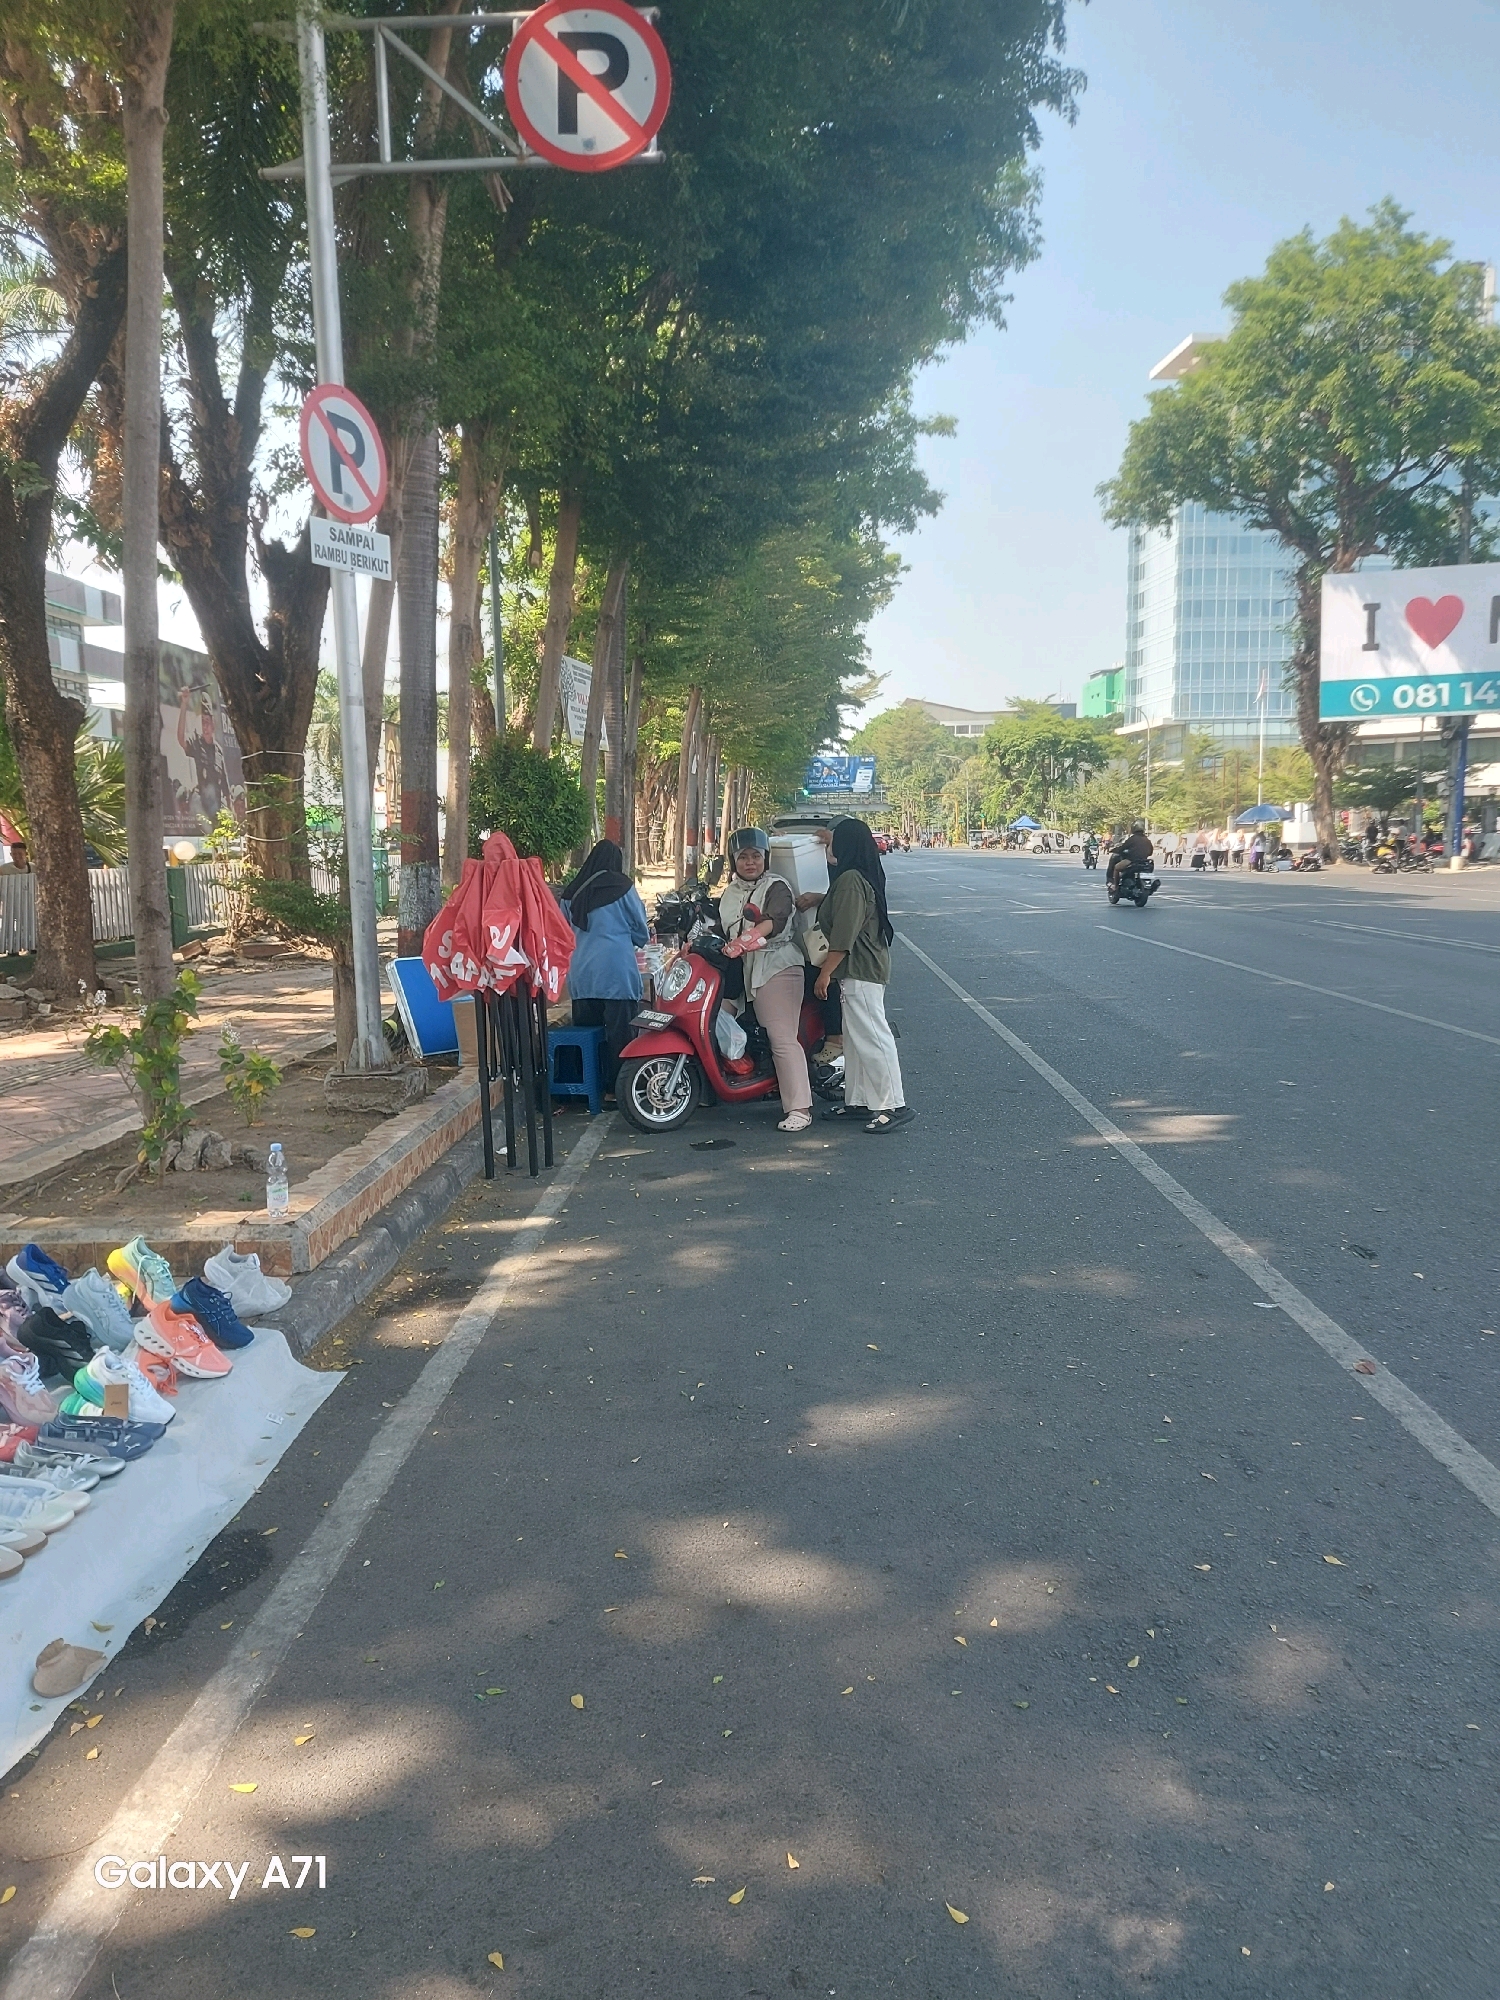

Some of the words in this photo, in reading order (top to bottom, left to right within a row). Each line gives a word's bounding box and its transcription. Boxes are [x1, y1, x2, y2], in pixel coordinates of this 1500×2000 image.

[557, 31, 630, 136] P
[326, 412, 365, 495] P
[313, 542, 348, 565] RAMBU
[350, 551, 389, 575] BERIKUT
[329, 526, 375, 552] SAMPAI
[1361, 602, 1382, 652] I
[1392, 682, 1451, 709] 081
[1459, 680, 1500, 706] 14
